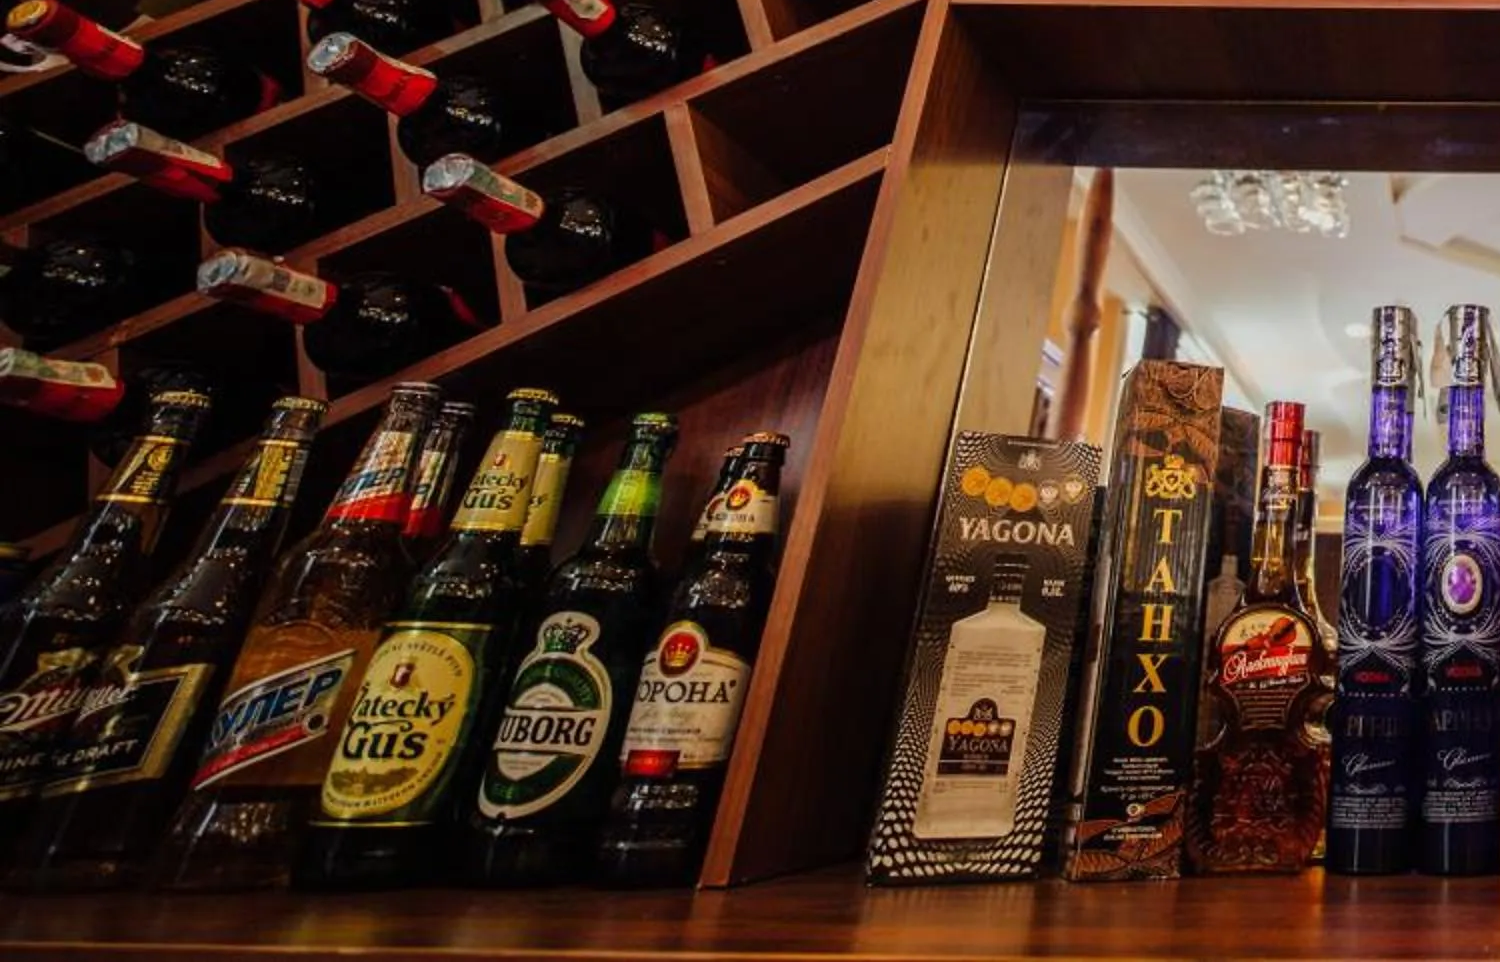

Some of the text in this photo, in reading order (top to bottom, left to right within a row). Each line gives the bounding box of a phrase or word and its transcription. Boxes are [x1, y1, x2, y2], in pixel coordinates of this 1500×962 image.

[959, 517, 1075, 547] YAGONA
[637, 680, 730, 704] ОРОНА
[342, 720, 429, 760] Gus
[500, 714, 597, 747] UBORG
